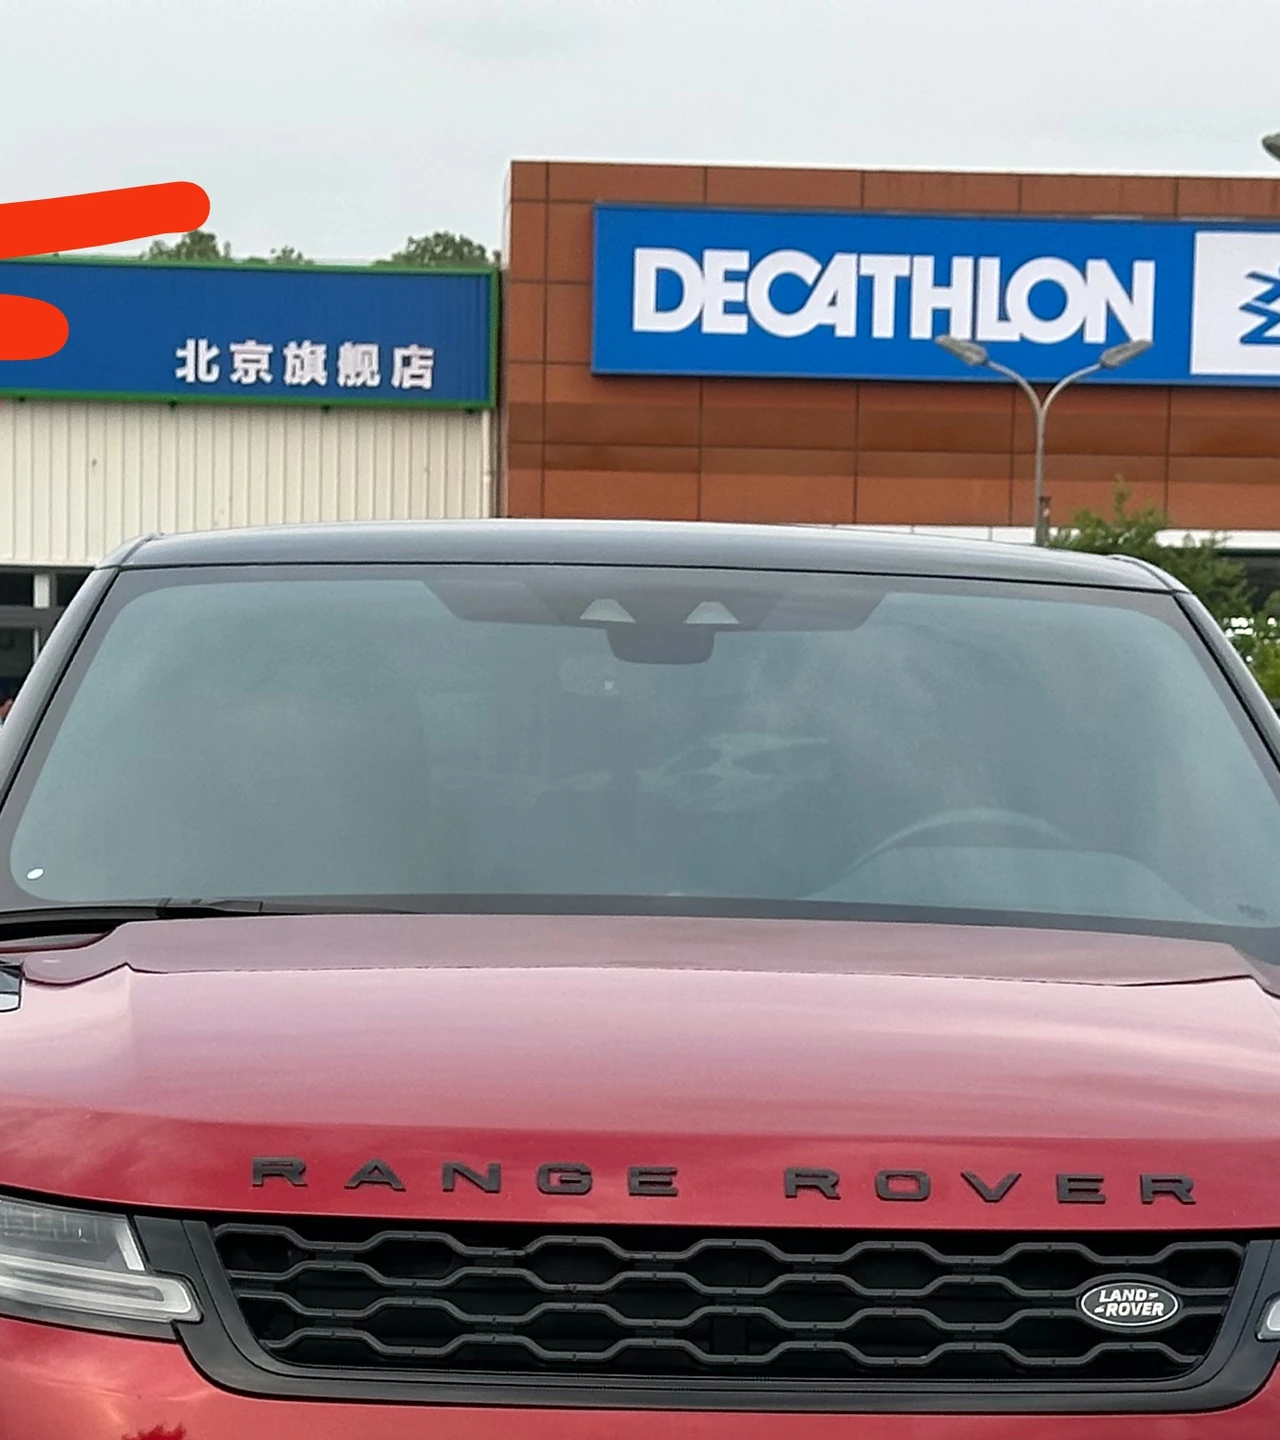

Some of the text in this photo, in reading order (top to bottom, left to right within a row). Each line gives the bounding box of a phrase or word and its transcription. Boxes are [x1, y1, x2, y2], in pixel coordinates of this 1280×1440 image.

[632, 247, 1156, 346] DECATHLON
[174, 338, 435, 390] 北京旗舰店
[251, 1156, 1197, 1206] RANGE ROVER
[1099, 1288, 1149, 1303] LAND
[1105, 1302, 1164, 1317] ROVER
